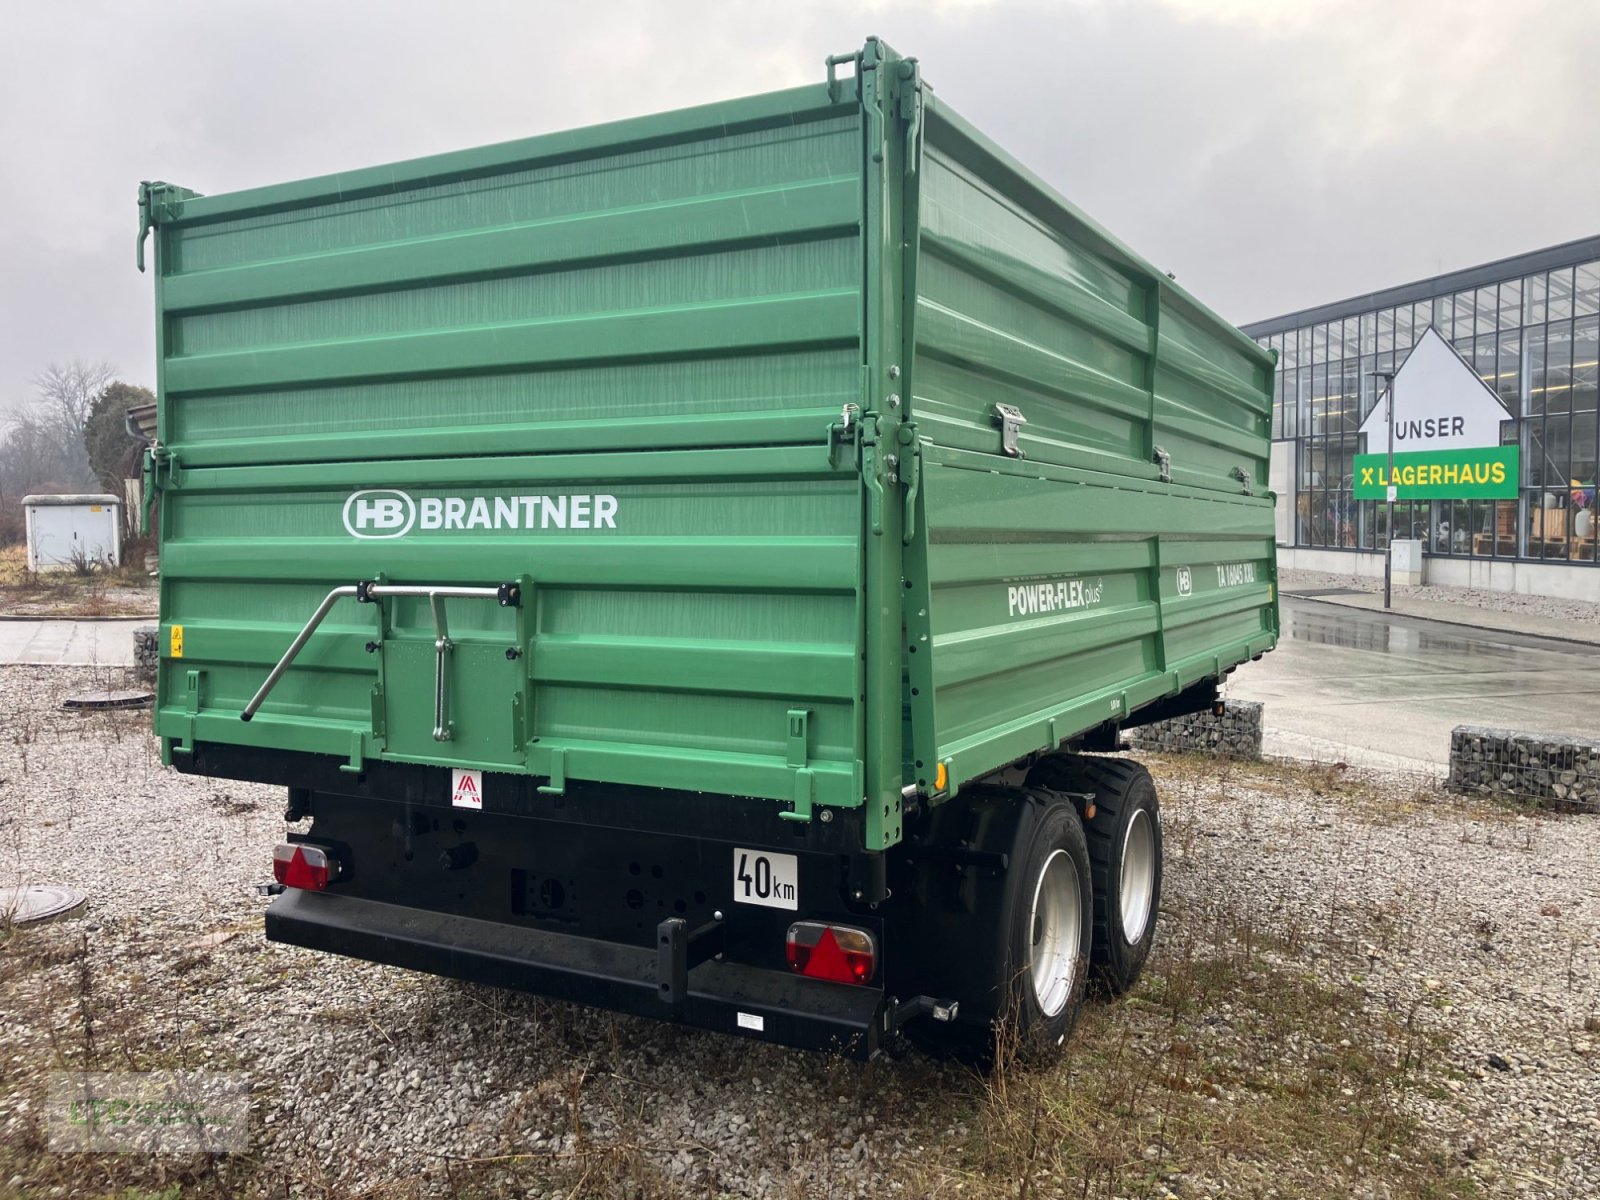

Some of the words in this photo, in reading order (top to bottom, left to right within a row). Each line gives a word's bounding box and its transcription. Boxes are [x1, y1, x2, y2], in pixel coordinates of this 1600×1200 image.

[1395, 416, 1465, 440] UNSER
[1378, 461, 1506, 486] LAGERHAUS
[420, 494, 619, 529] BRANTNER
[1216, 564, 1227, 588] TA
[1008, 580, 1085, 617] POWER-FLEX
[737, 853, 771, 899] 40
[773, 875, 795, 900] km
